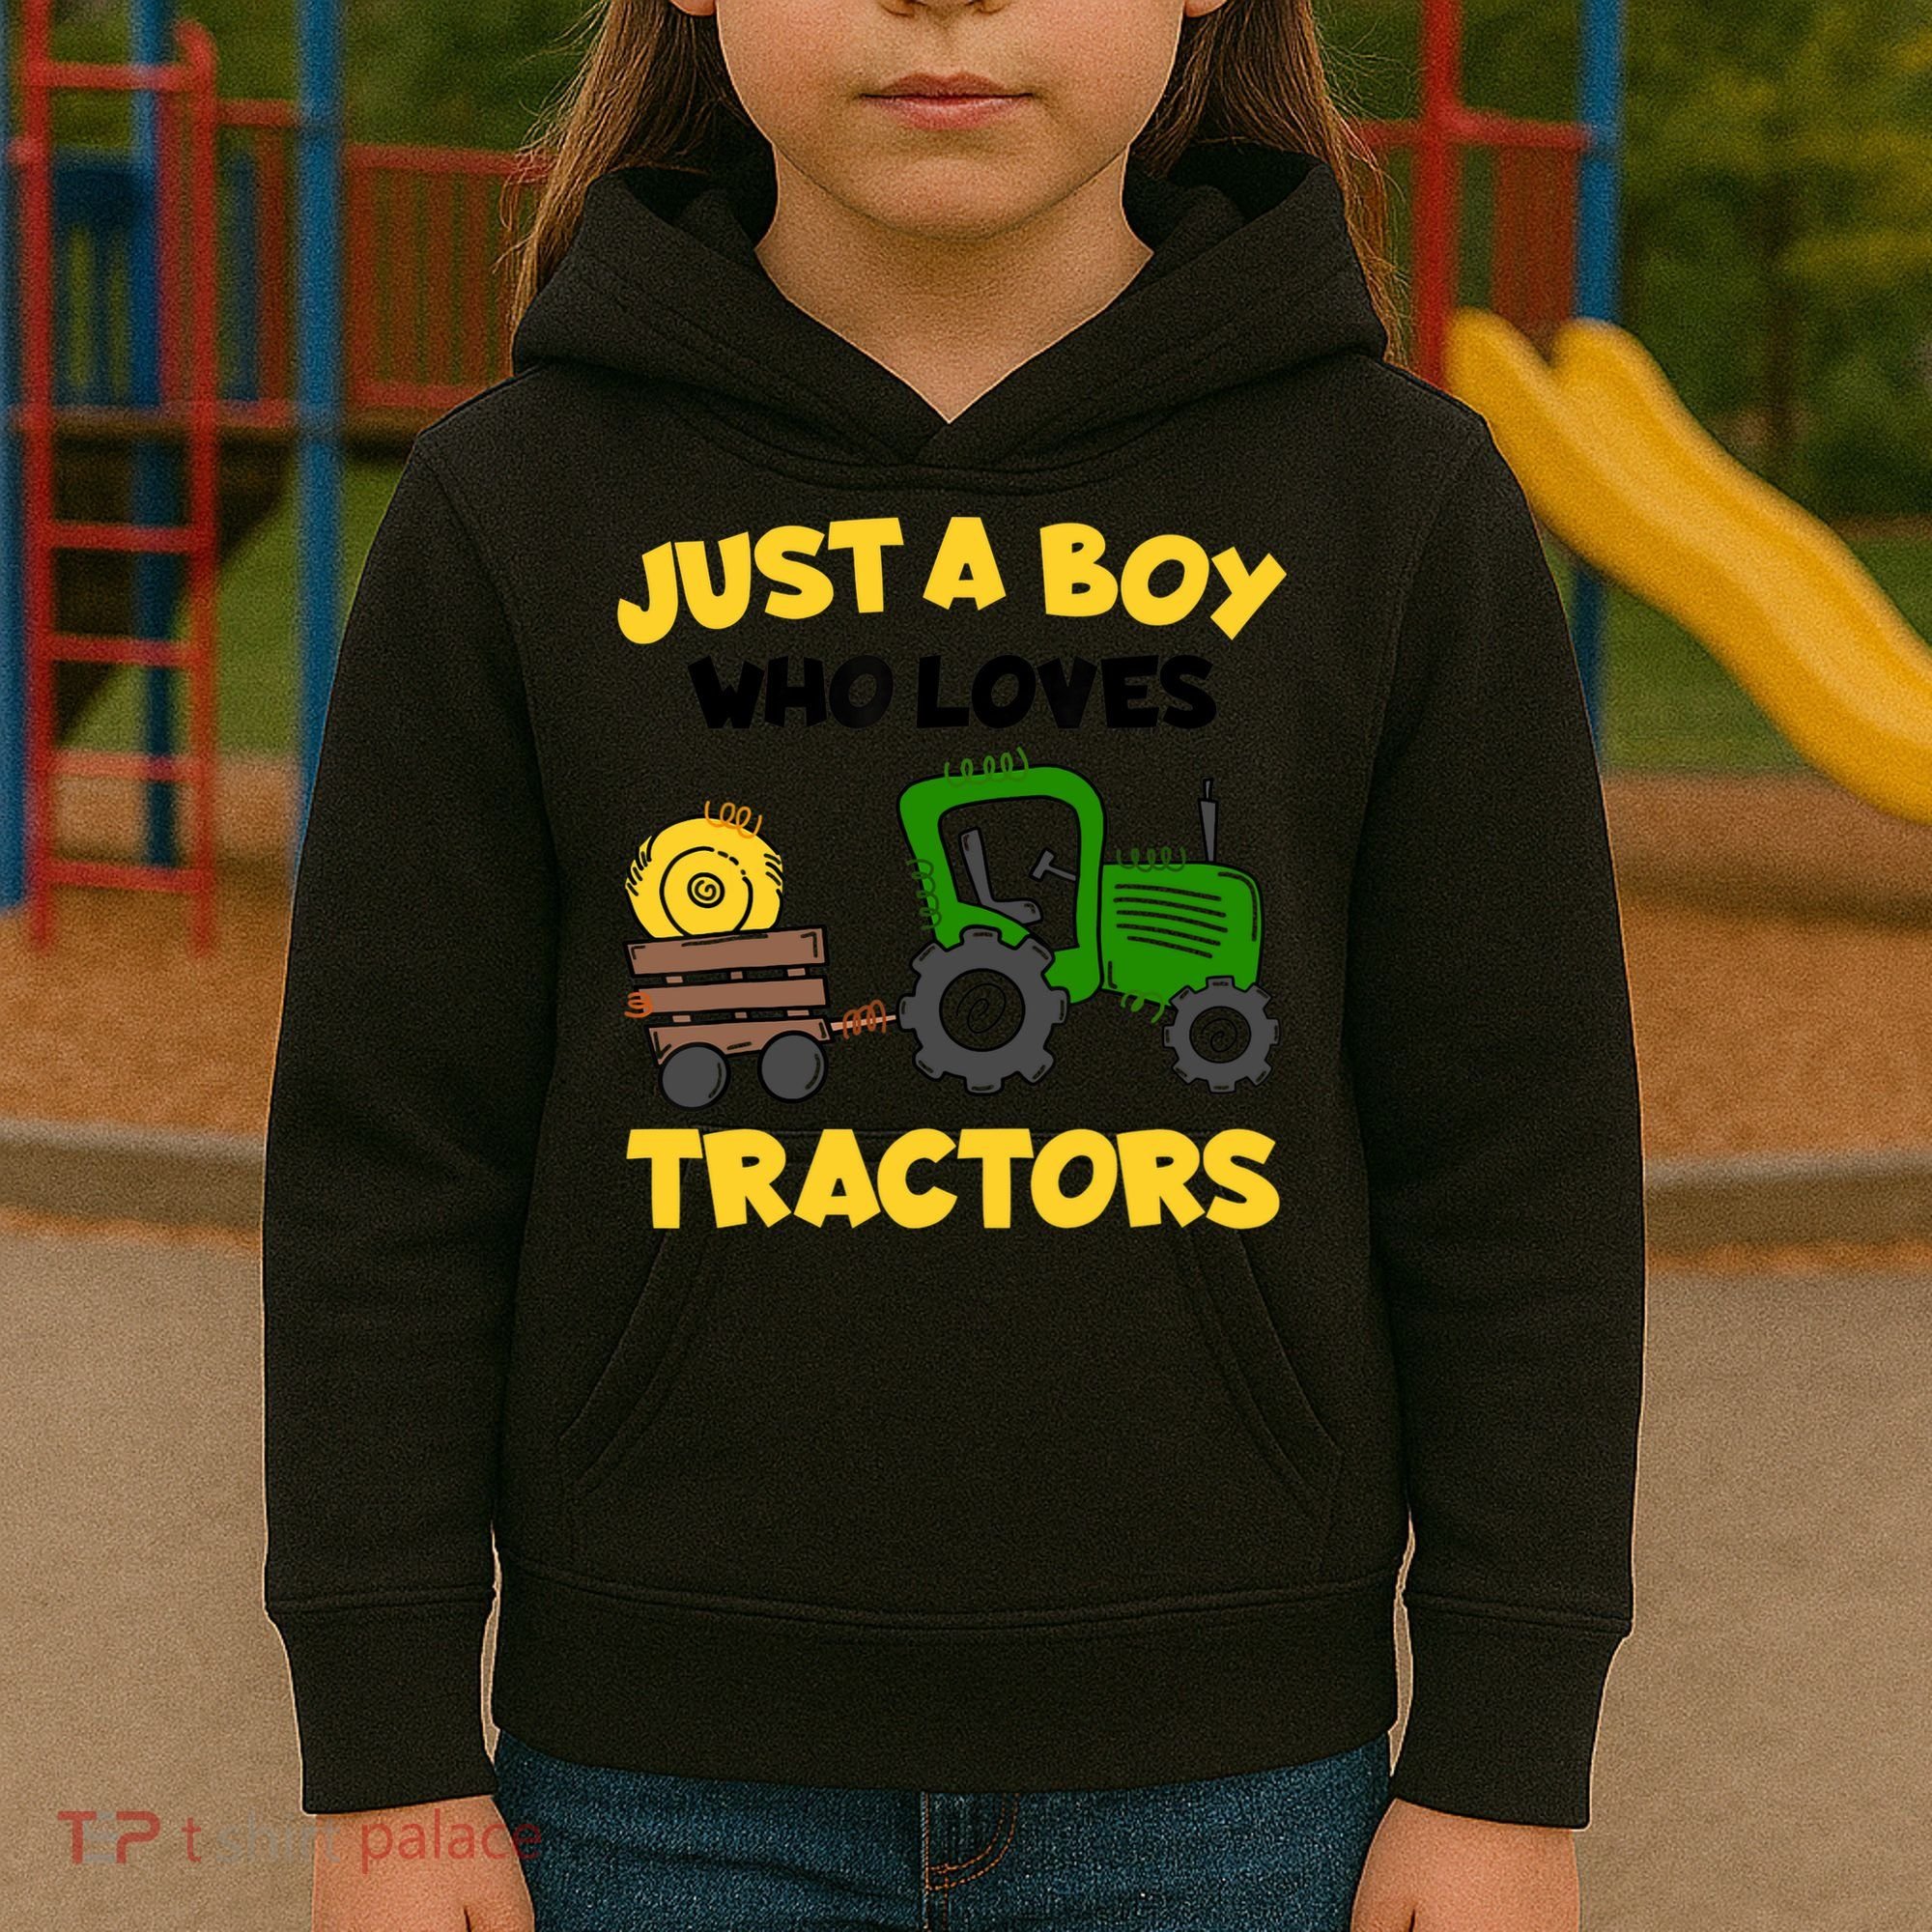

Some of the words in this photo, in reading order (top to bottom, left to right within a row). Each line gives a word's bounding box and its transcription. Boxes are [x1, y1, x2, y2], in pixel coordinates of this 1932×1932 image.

[617, 517, 904, 644] JUST
[923, 516, 1007, 611] A
[1039, 523, 1287, 640] BOY
[687, 655, 894, 729] WHO
[916, 655, 1217, 729] LOVES
[626, 1128, 1281, 1230] TRACTORS
